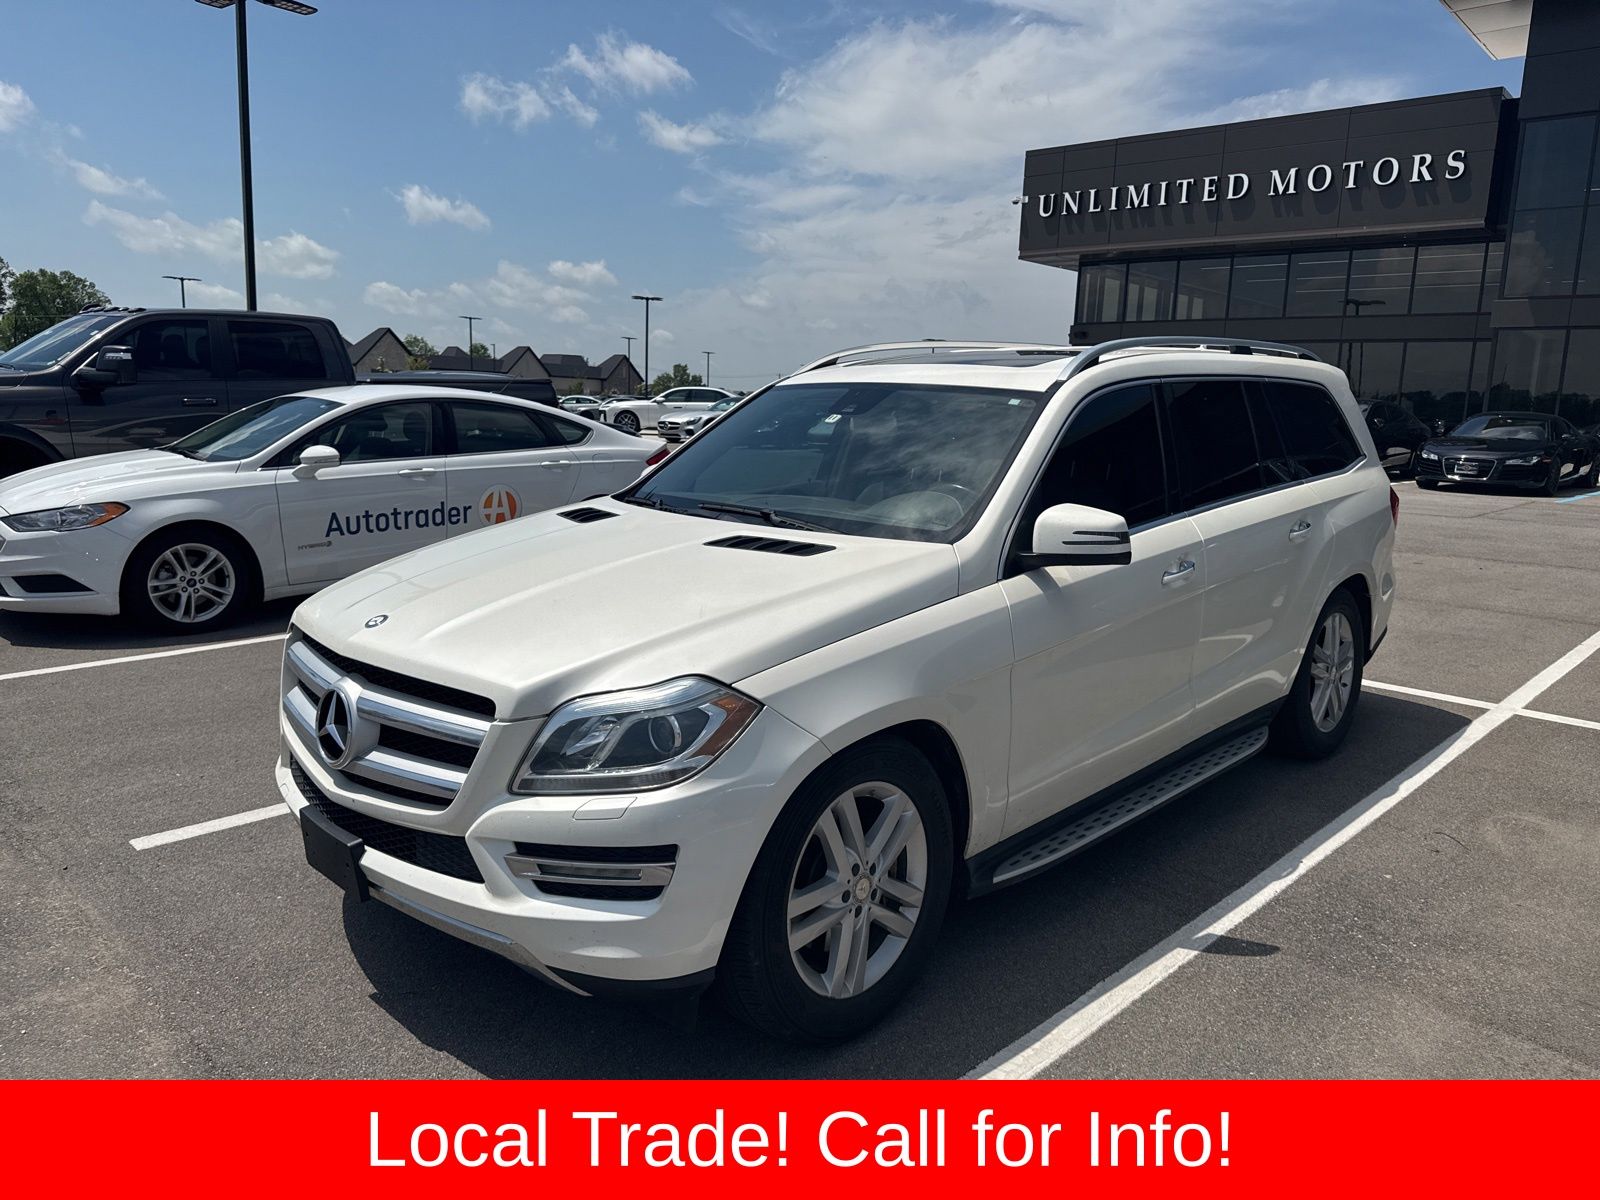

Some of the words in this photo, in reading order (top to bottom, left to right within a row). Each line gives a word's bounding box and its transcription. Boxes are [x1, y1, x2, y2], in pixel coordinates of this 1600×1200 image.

[1038, 173, 1249, 218] UNLIMITED
[1268, 150, 1465, 196] MOTORS
[325, 501, 472, 537] Autotrader
[297, 541, 326, 551] HYD
